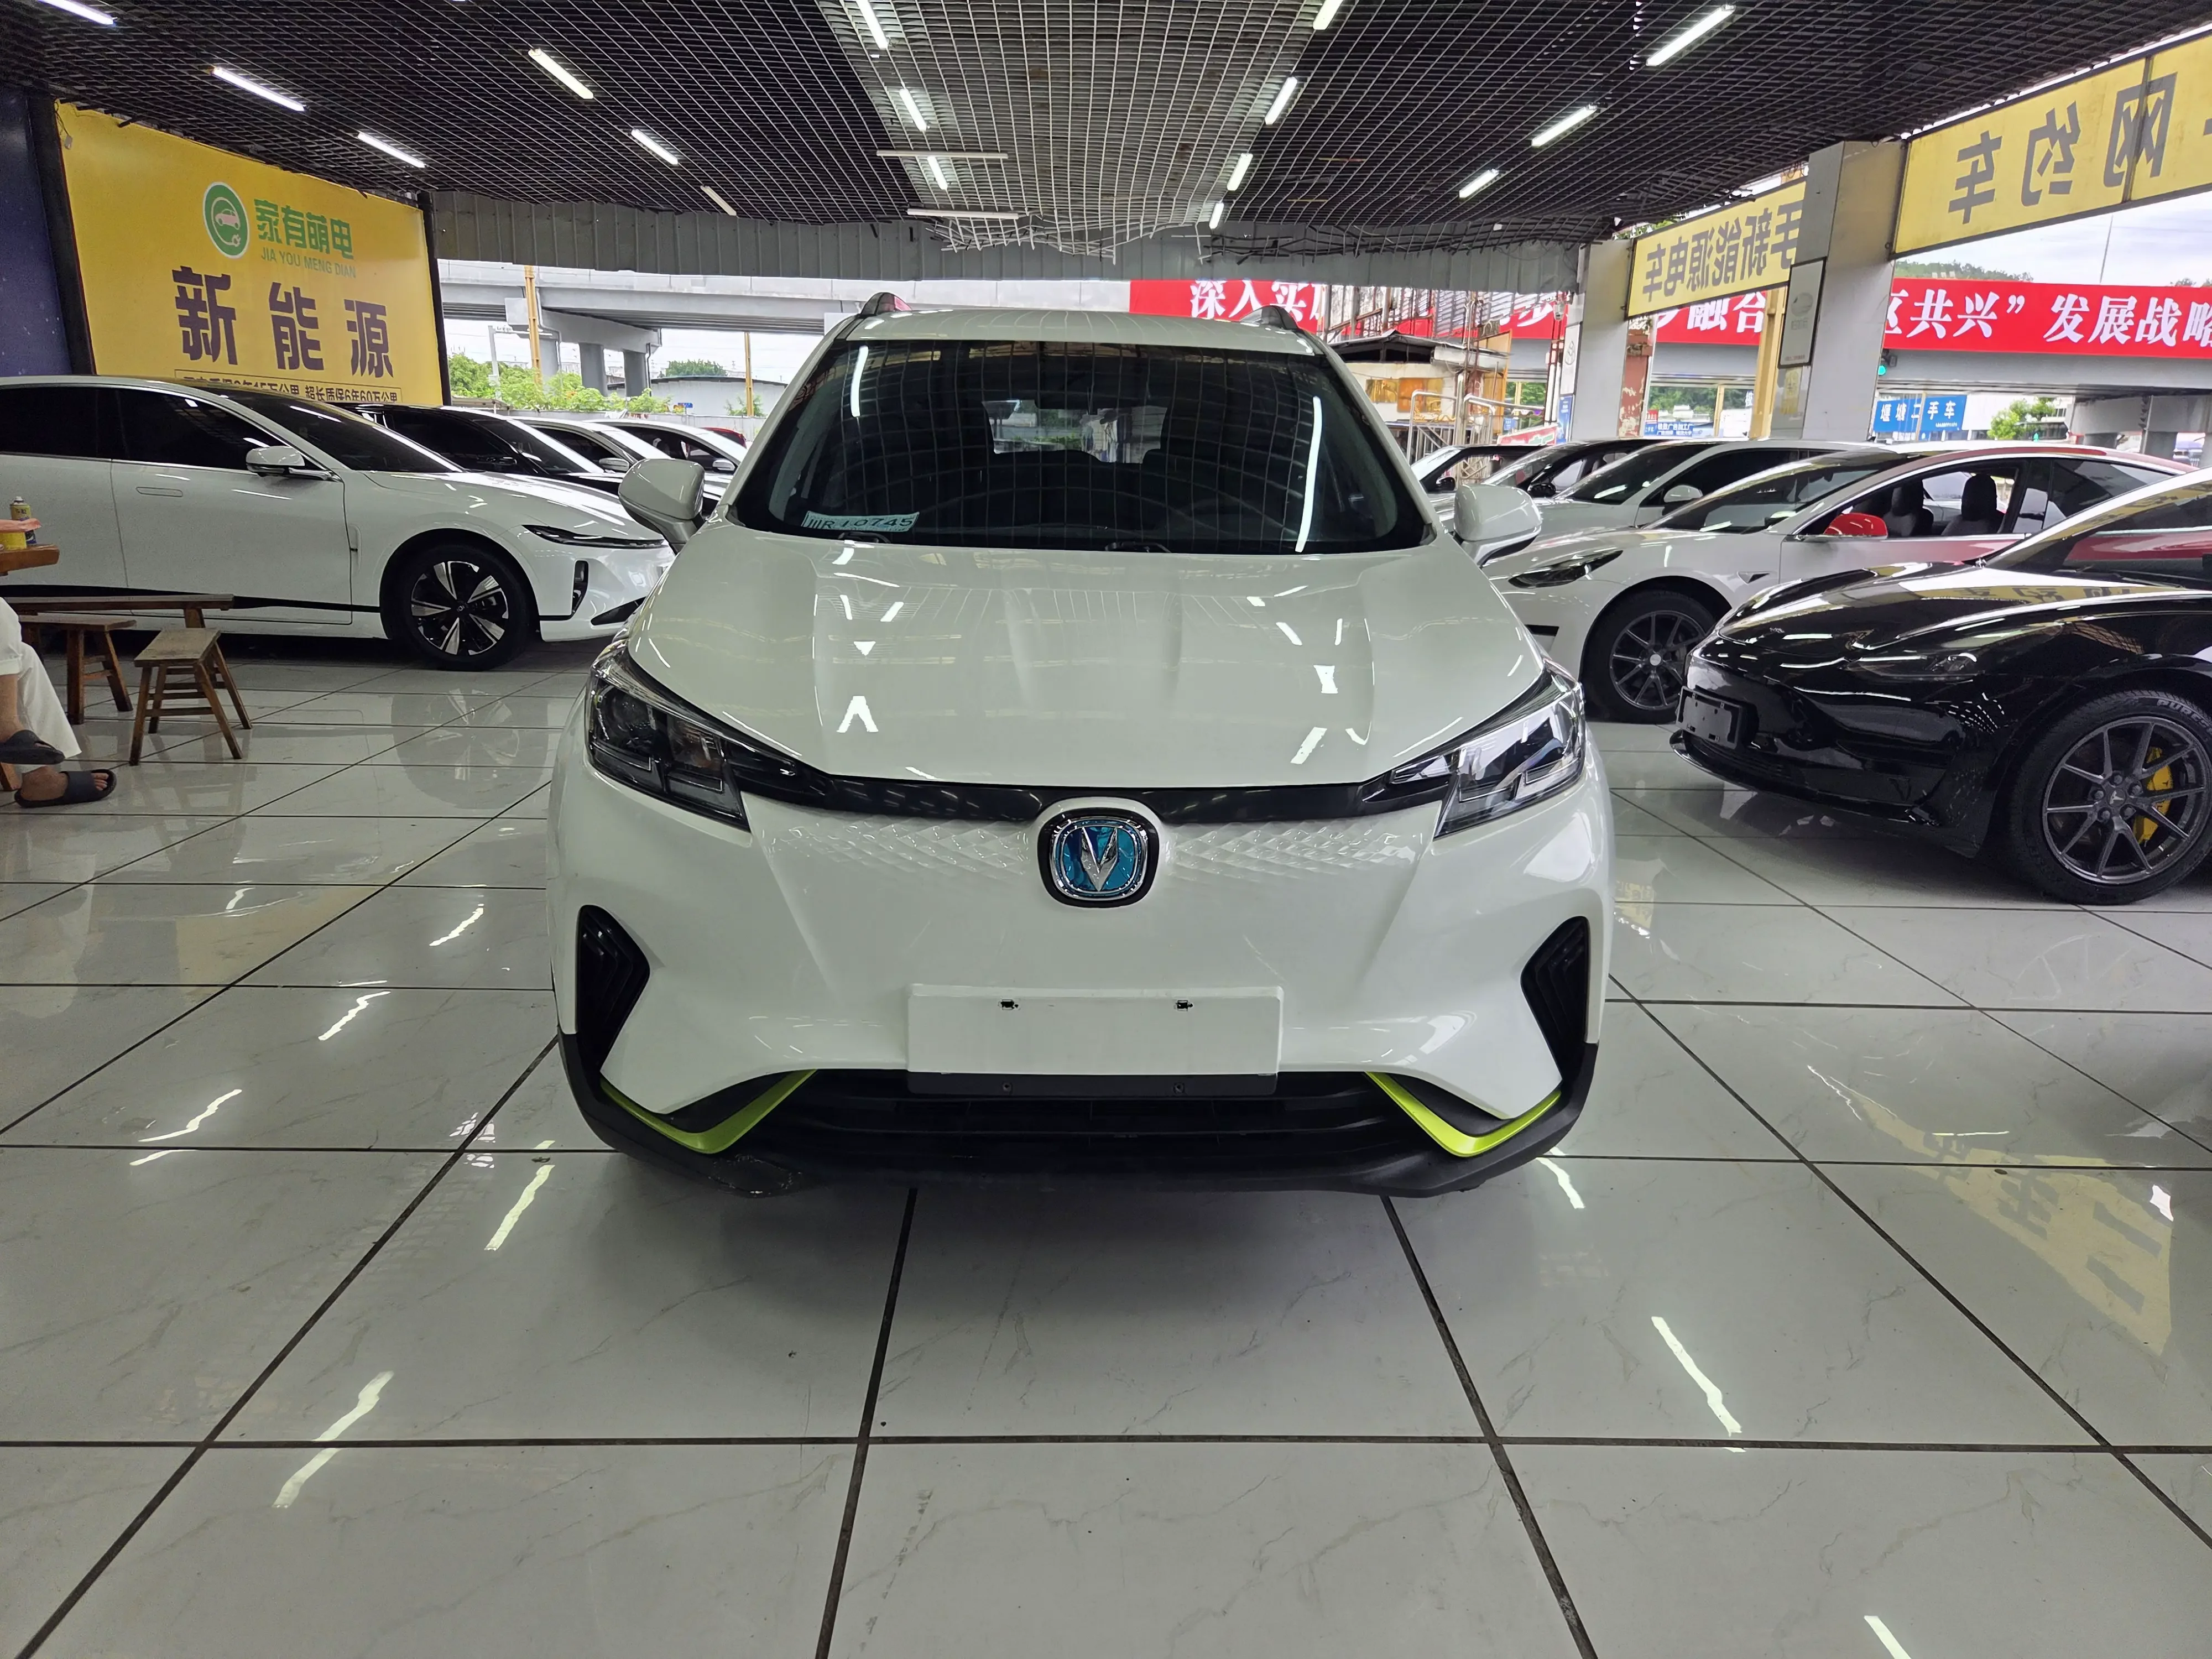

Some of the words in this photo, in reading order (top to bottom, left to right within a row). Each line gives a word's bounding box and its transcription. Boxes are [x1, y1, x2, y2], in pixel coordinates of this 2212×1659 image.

[253, 199, 354, 260] 家有萌电
[261, 247, 278, 263] JIA
[279, 251, 301, 267] YOU
[304, 256, 332, 274] MENG
[335, 263, 357, 278] DIAN
[172, 265, 393, 378] 新能源
